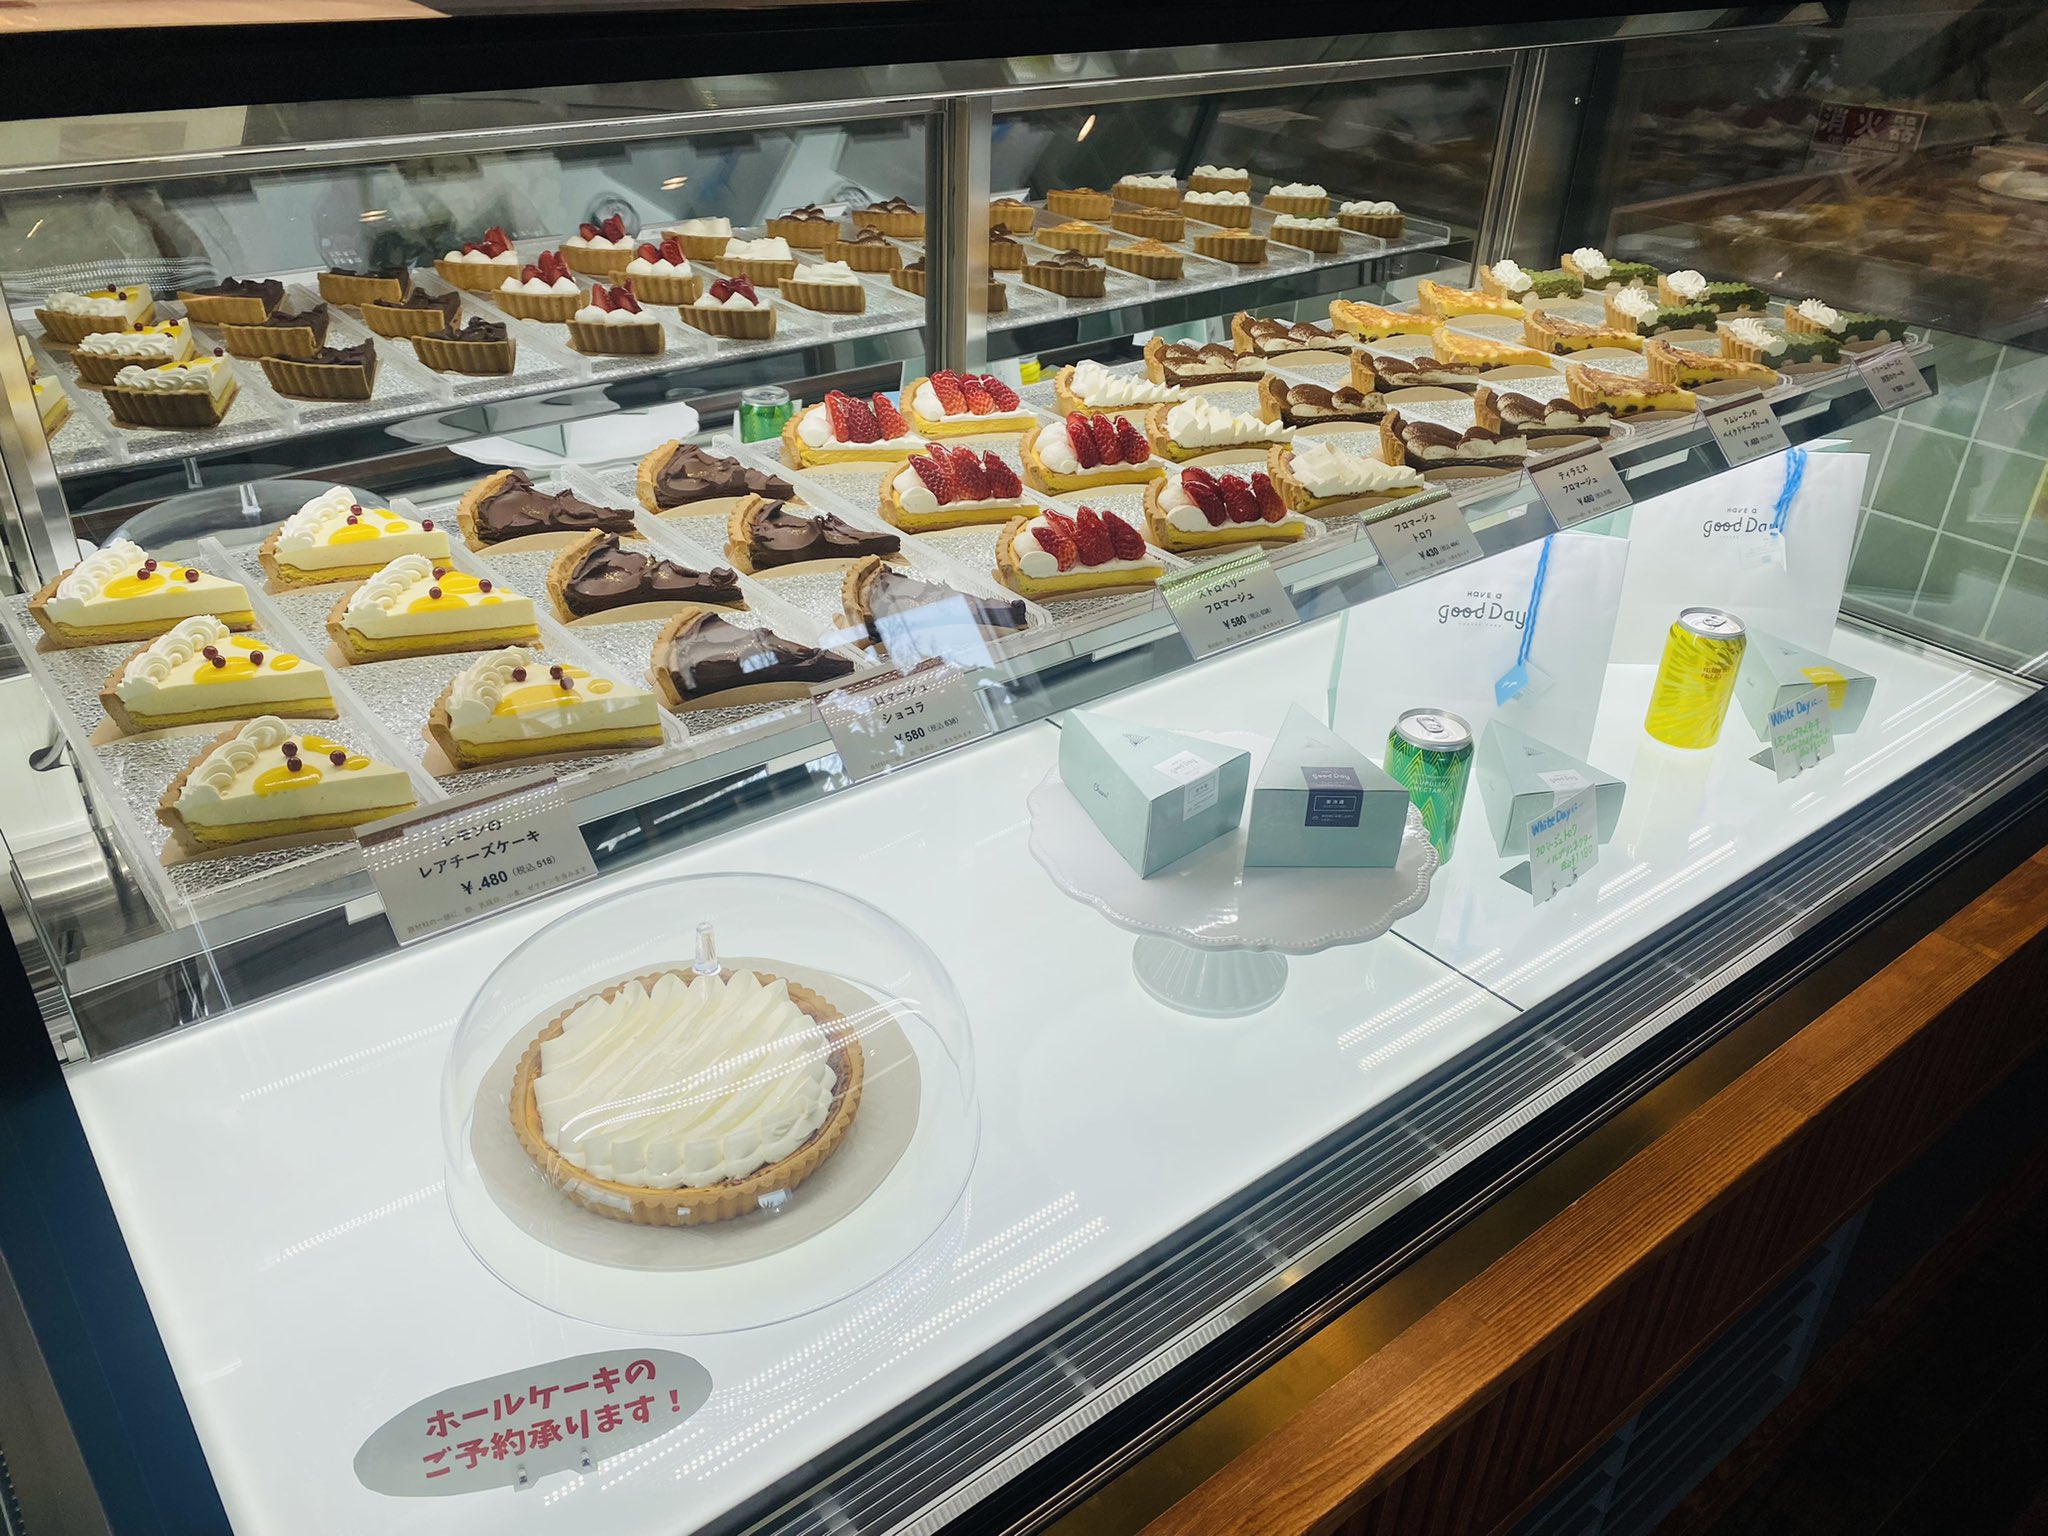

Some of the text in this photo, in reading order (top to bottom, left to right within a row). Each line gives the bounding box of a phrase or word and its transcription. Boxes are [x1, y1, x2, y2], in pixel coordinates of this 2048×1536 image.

[1820, 106, 1918, 143] 消火器
[1558, 464, 1588, 480] ティラミス
[1562, 476, 1598, 493] フロマージュ
[1394, 513, 1436, 532] フロマージュ
[1412, 528, 1433, 542] トロワ
[1198, 577, 1246, 599] ストロベリー
[1204, 592, 1255, 614] フロマージュ
[862, 684, 928, 709] ロマージュ
[882, 701, 925, 724] ショコラ
[442, 819, 502, 847] レモンの
[418, 829, 541, 878] レアチーズケーキ
[425, 1358, 657, 1438] ホールケーキの
[422, 1388, 682, 1479] ご予約承ります!
